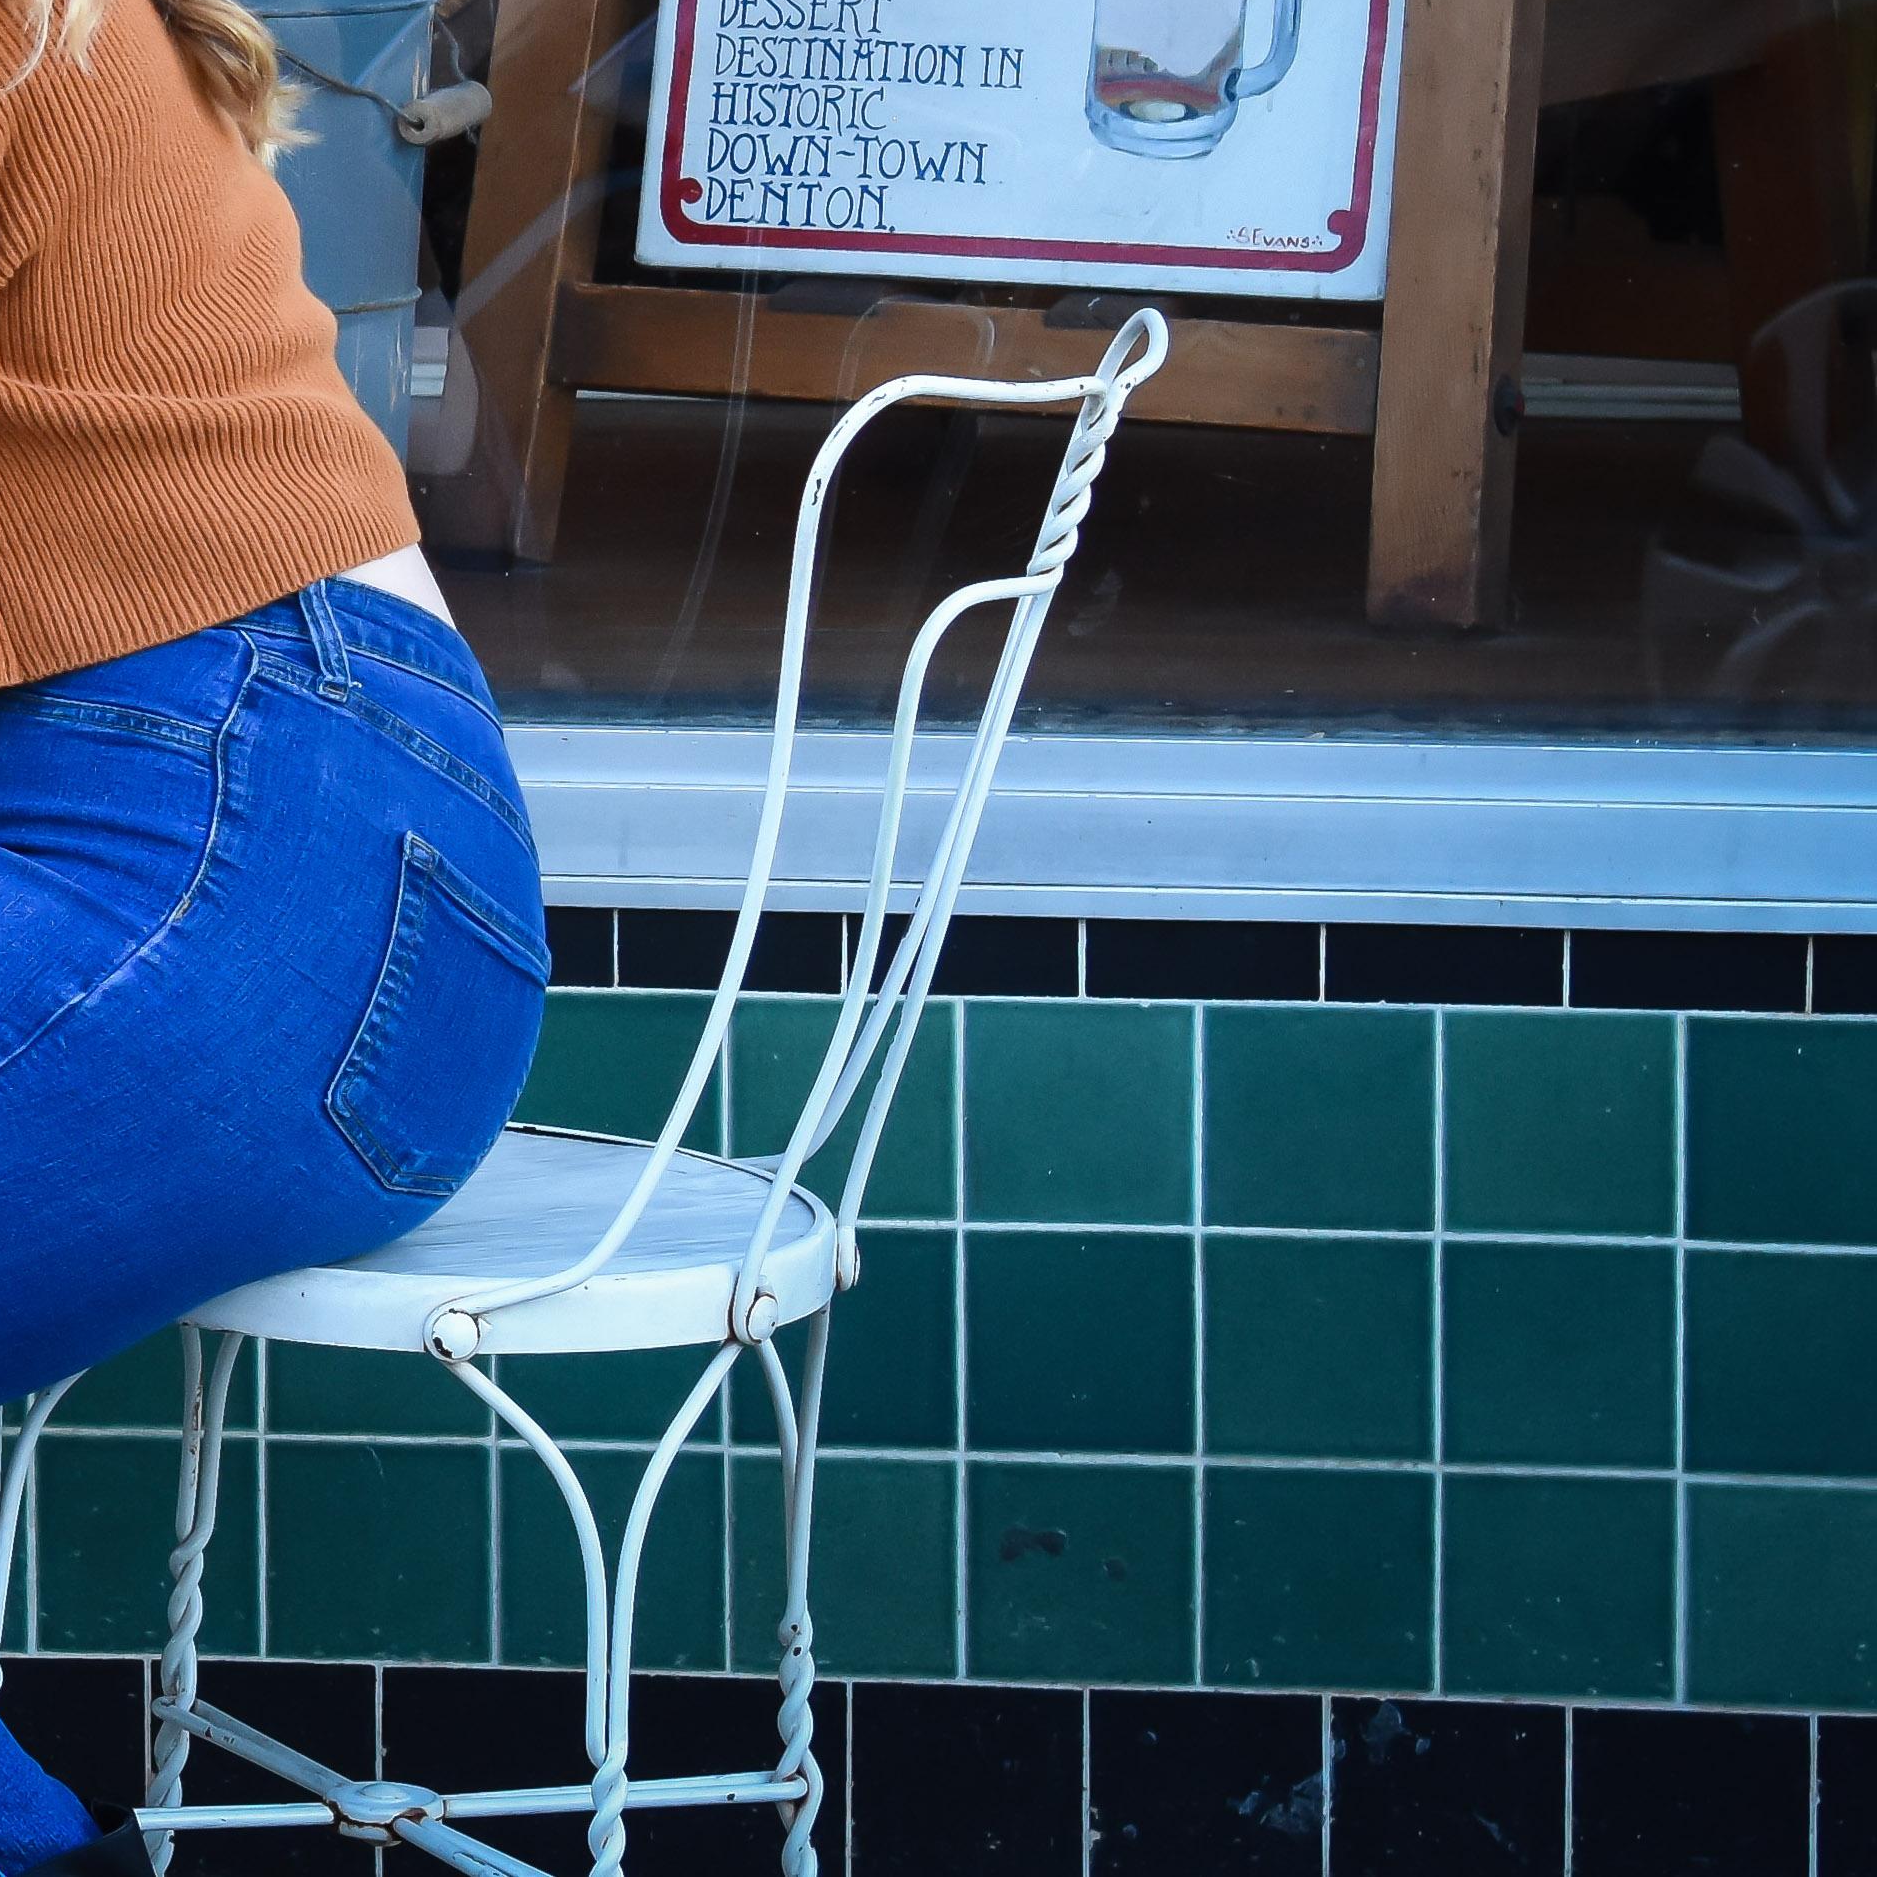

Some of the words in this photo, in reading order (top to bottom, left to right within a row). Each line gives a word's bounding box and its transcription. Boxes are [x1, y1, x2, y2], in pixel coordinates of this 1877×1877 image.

[715, 33, 967, 87] DESTINATION
[979, 47, 1024, 89] IN
[709, 82, 887, 136] HISTORIC
[707, 127, 988, 184] DOWN-TOWN
[705, 176, 896, 233] DENTON.
